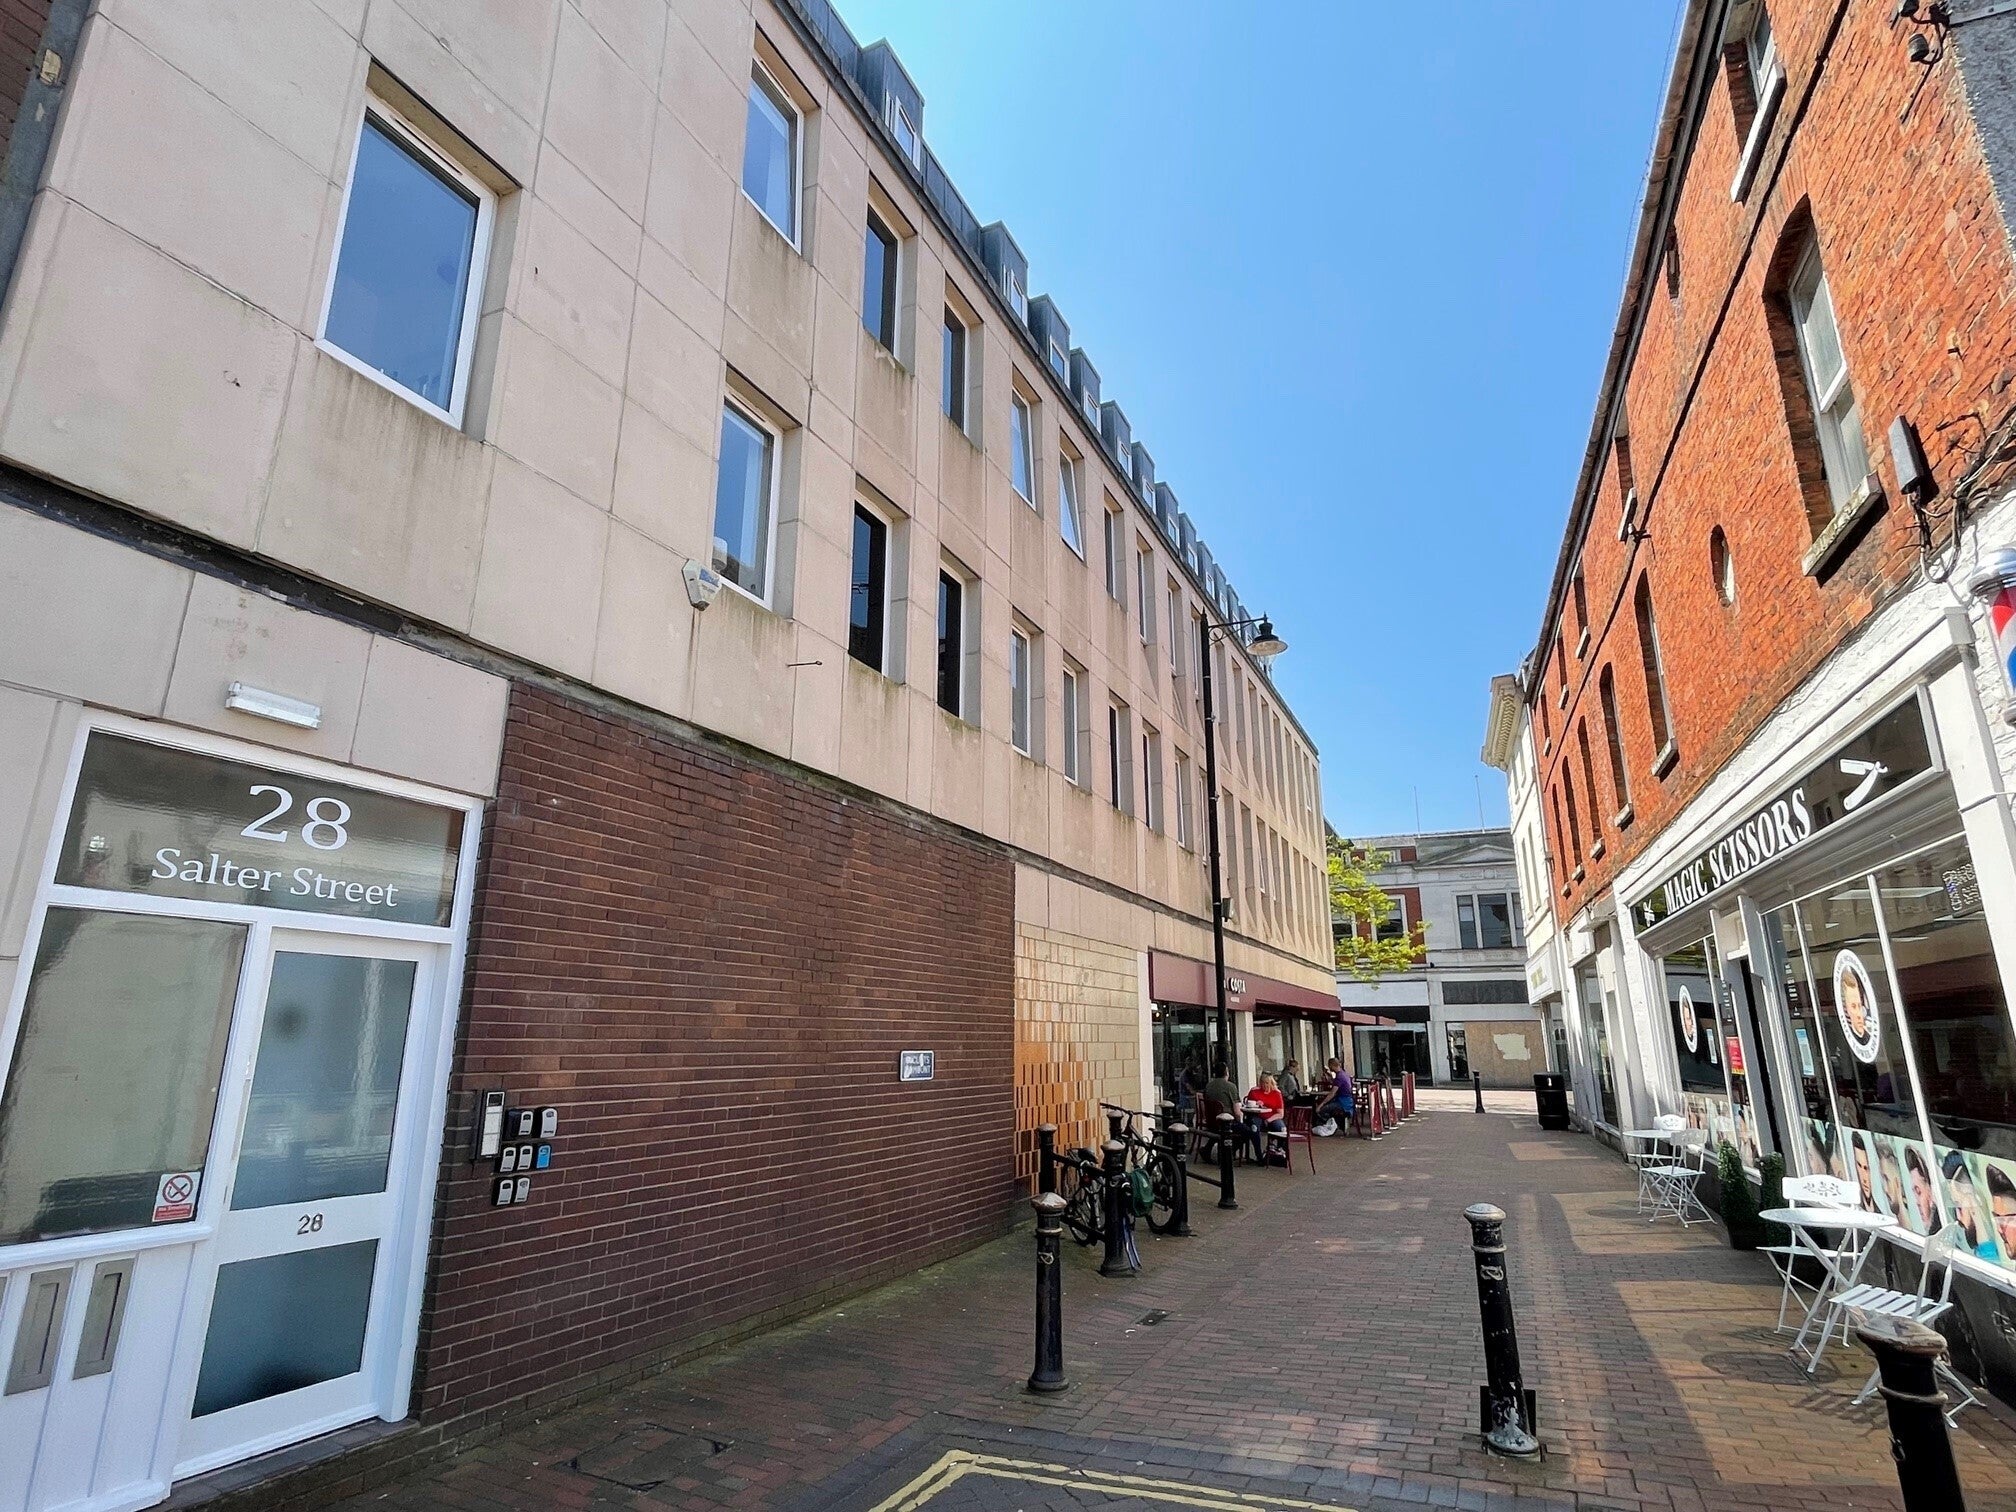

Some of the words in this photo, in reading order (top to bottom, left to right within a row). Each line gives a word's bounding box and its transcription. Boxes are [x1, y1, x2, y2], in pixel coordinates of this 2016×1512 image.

[240, 784, 351, 850] 28
[151, 847, 281, 892] Salter
[290, 867, 399, 907] Street
[1663, 858, 1708, 915] MAGIC
[1708, 787, 1811, 888] SCISSORS
[297, 1213, 323, 1235] 28
